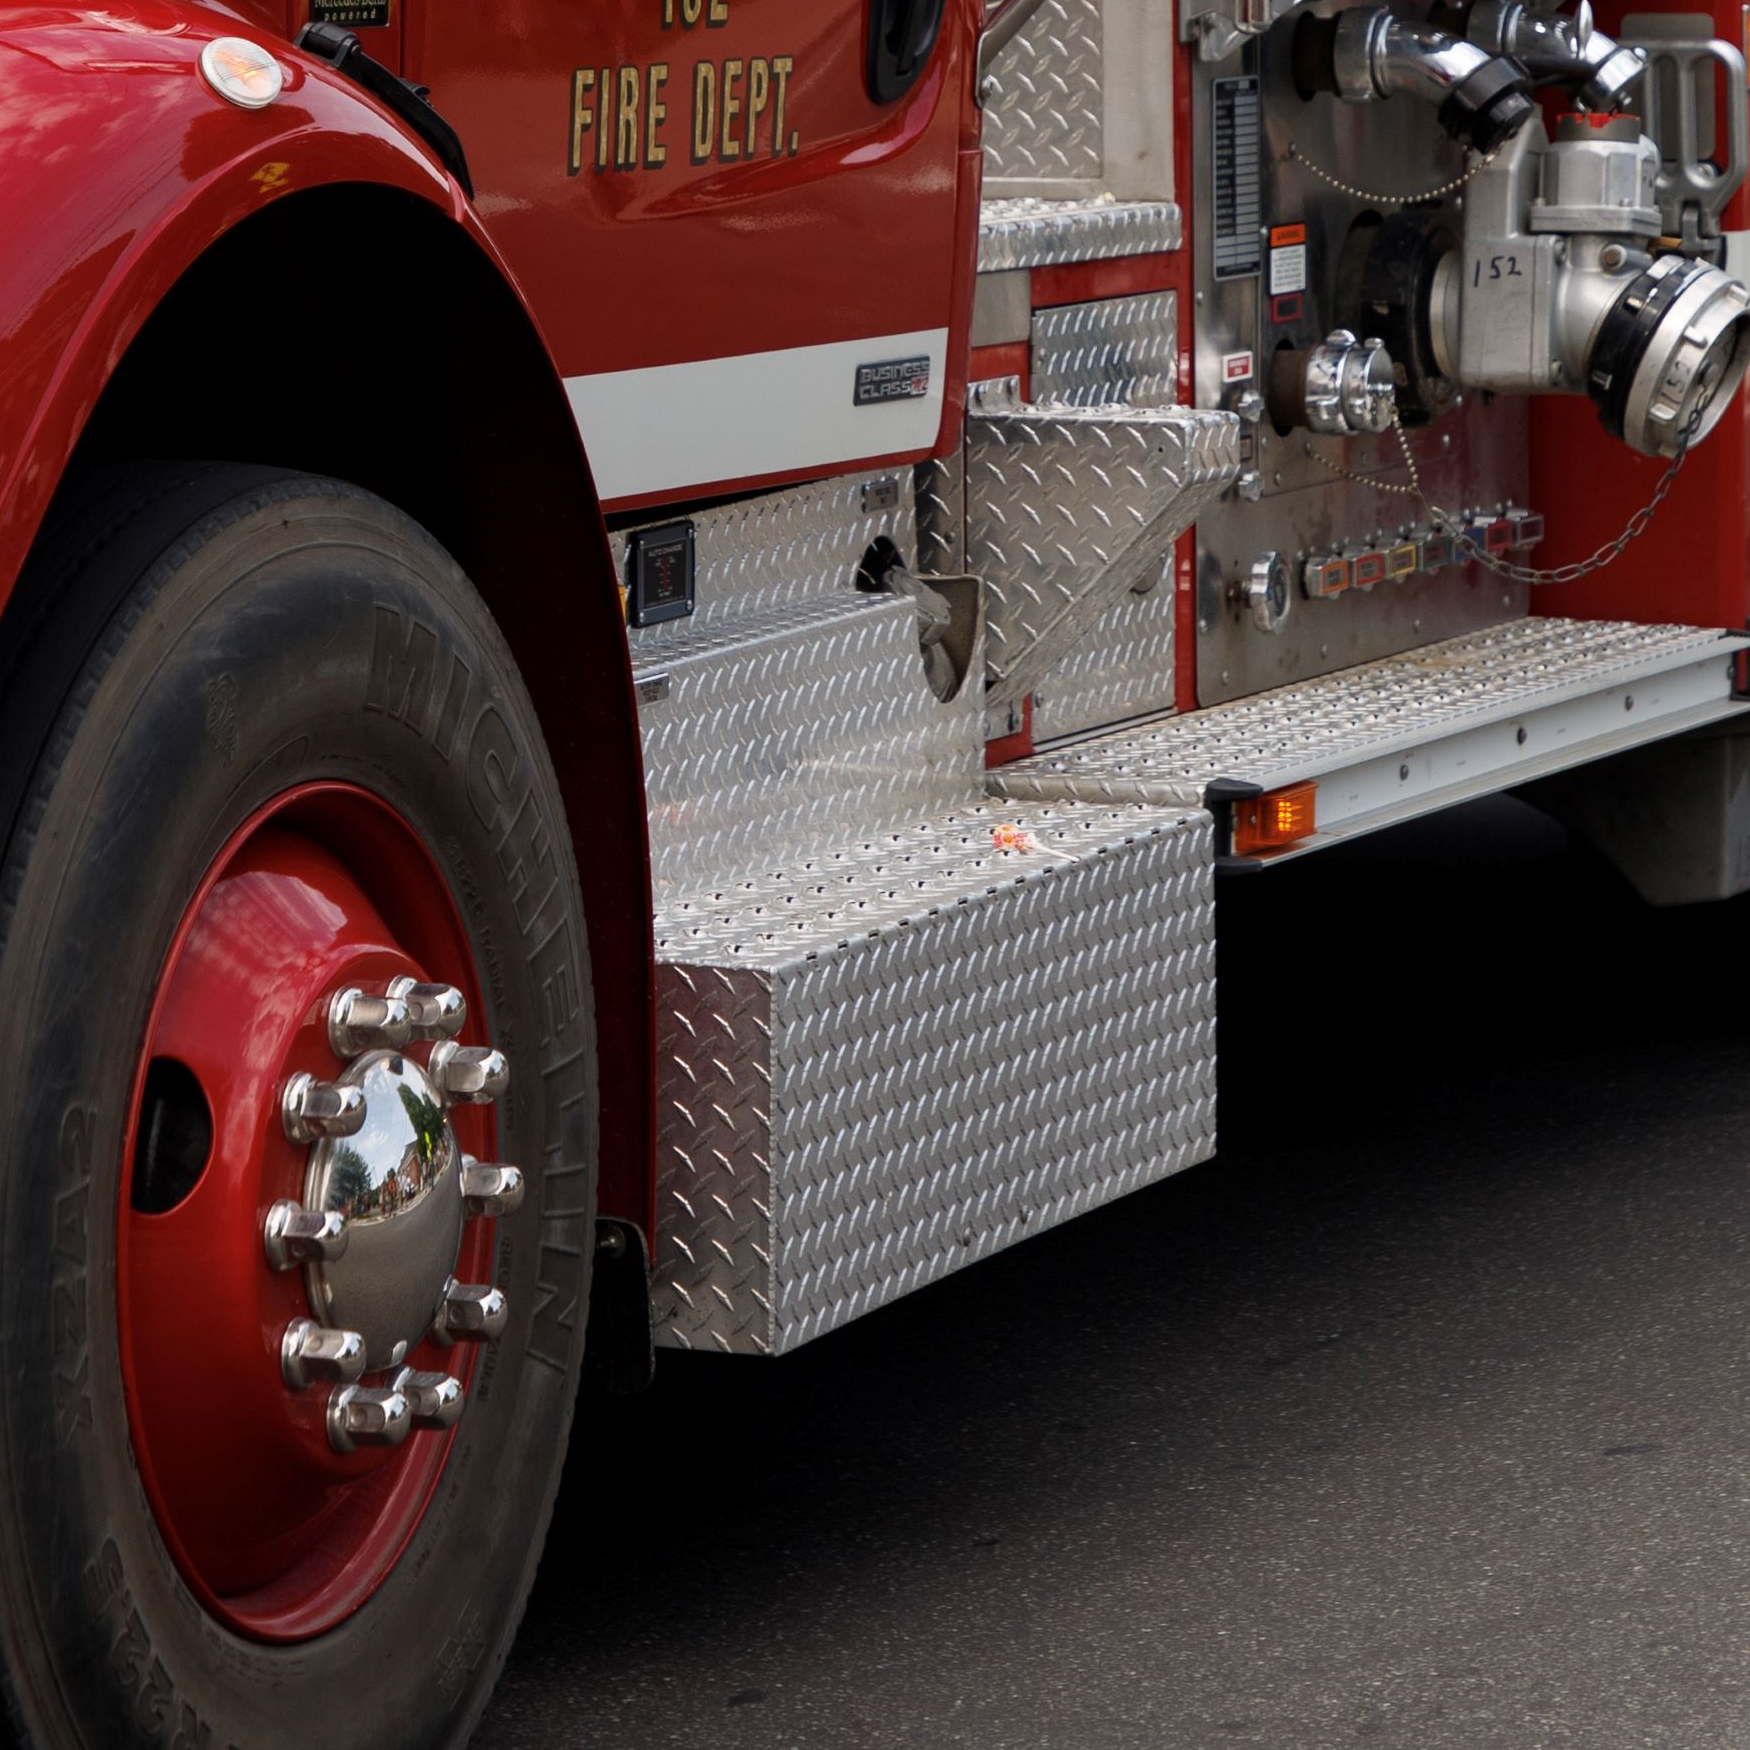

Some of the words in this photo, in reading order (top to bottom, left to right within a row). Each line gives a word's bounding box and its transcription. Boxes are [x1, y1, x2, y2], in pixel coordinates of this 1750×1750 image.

[324, 7, 376, 22] powered
[568, 64, 669, 175] FIRE
[691, 55, 799, 166] DEPT.
[1473, 255, 1523, 289] 152
